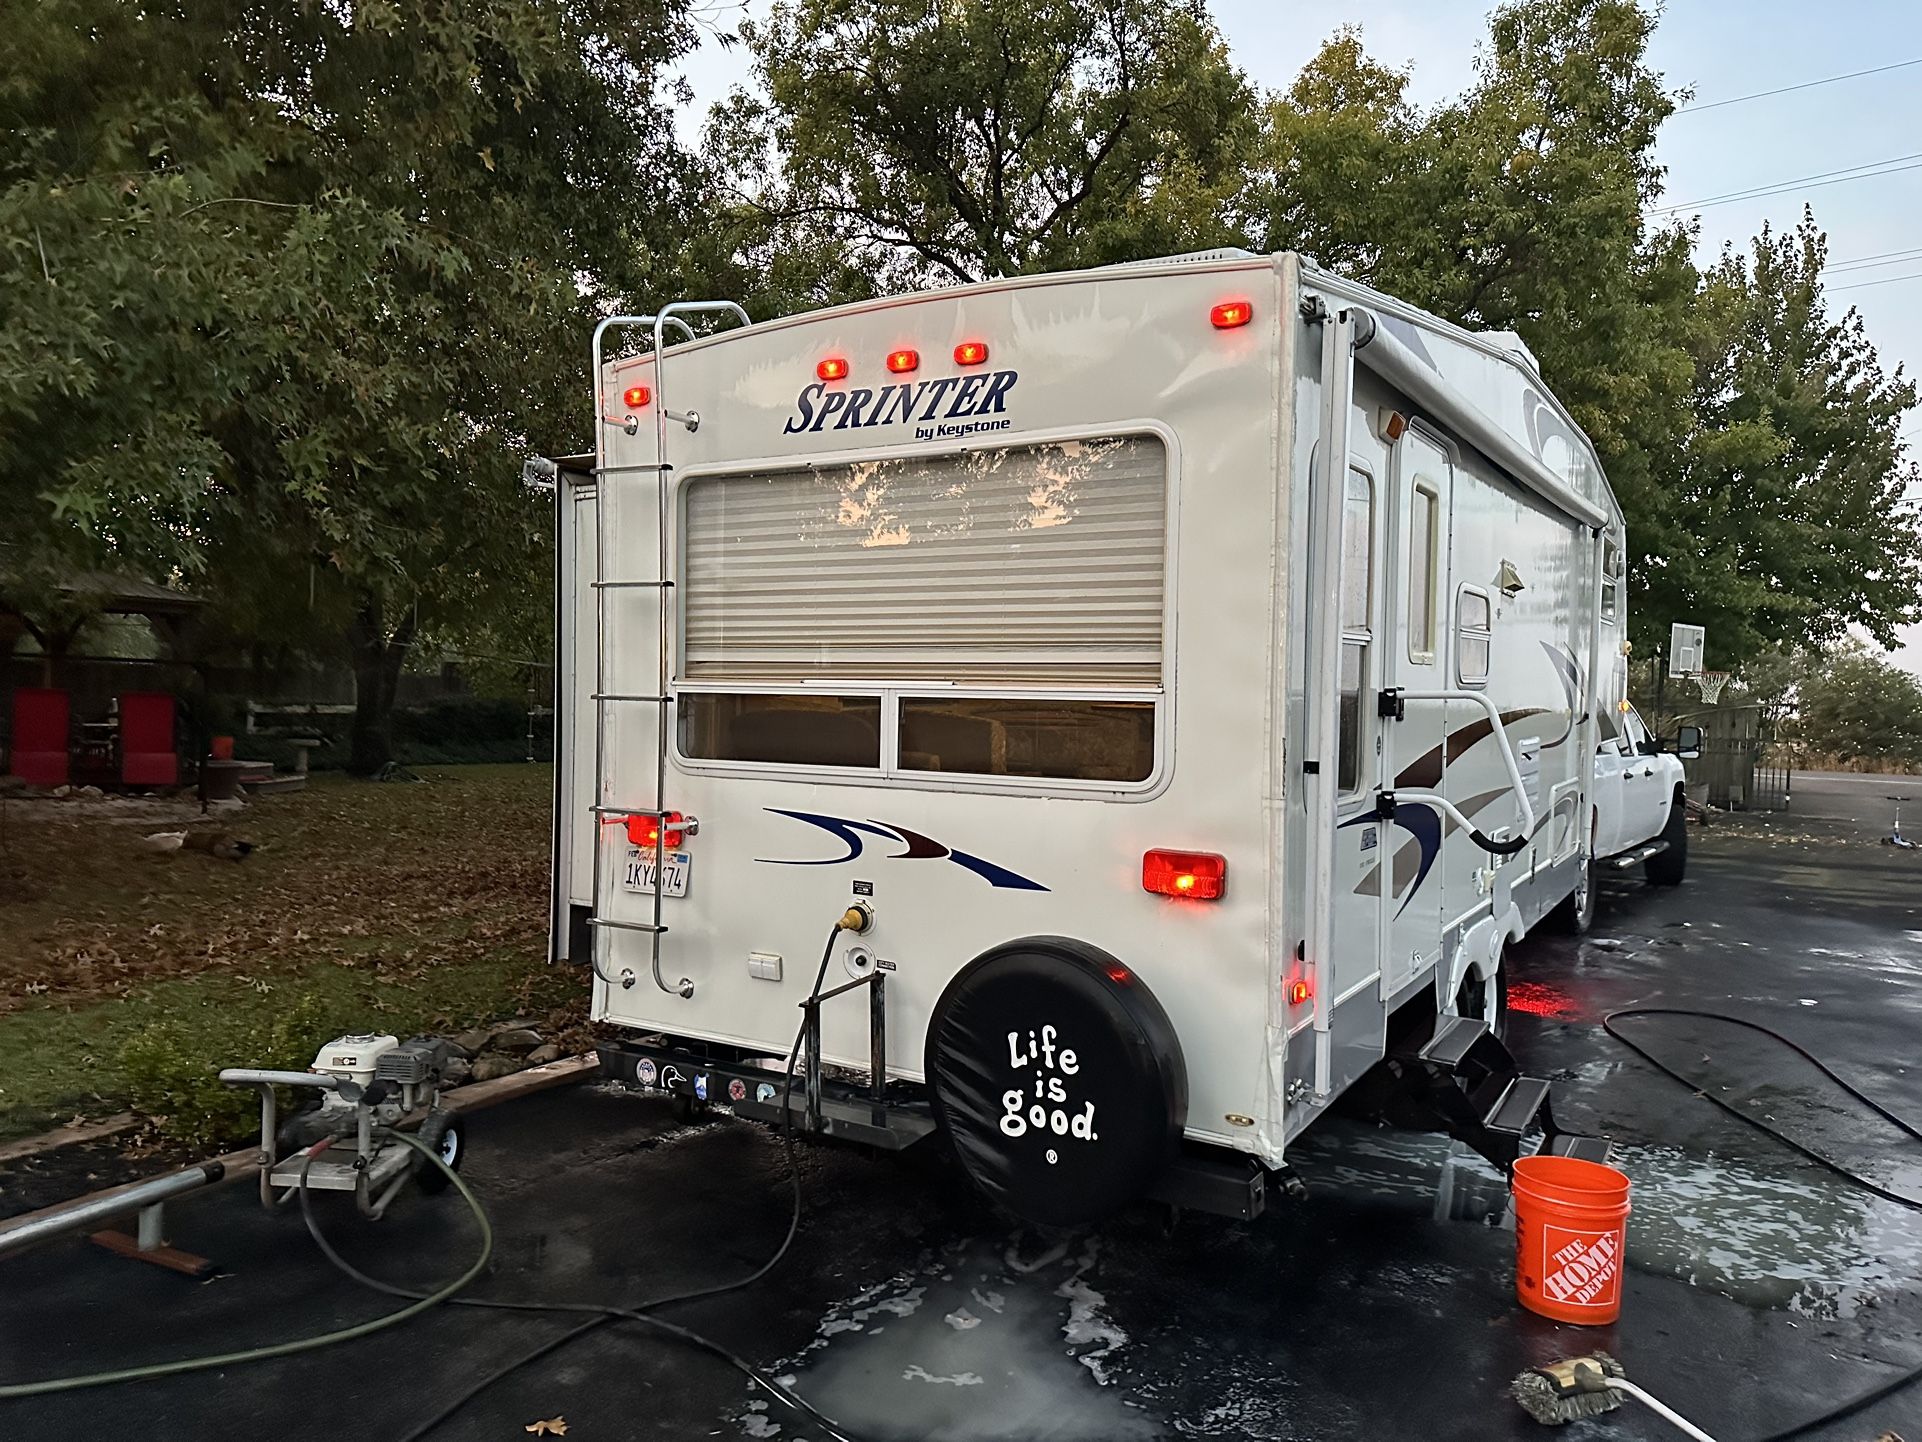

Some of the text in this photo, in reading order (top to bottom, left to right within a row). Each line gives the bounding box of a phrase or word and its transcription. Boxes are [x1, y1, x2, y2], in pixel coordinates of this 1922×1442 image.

[783, 370, 1018, 435] SPRINTER
[915, 418, 1011, 441] by Keystone
[1007, 1024, 1080, 1075] Life
[1036, 1070, 1067, 1103] is
[999, 1089, 1098, 1141] good.
[1545, 1232, 1618, 1301] HOME
[1552, 1239, 1588, 1266] THE
[1574, 1258, 1617, 1304] DEPOT
